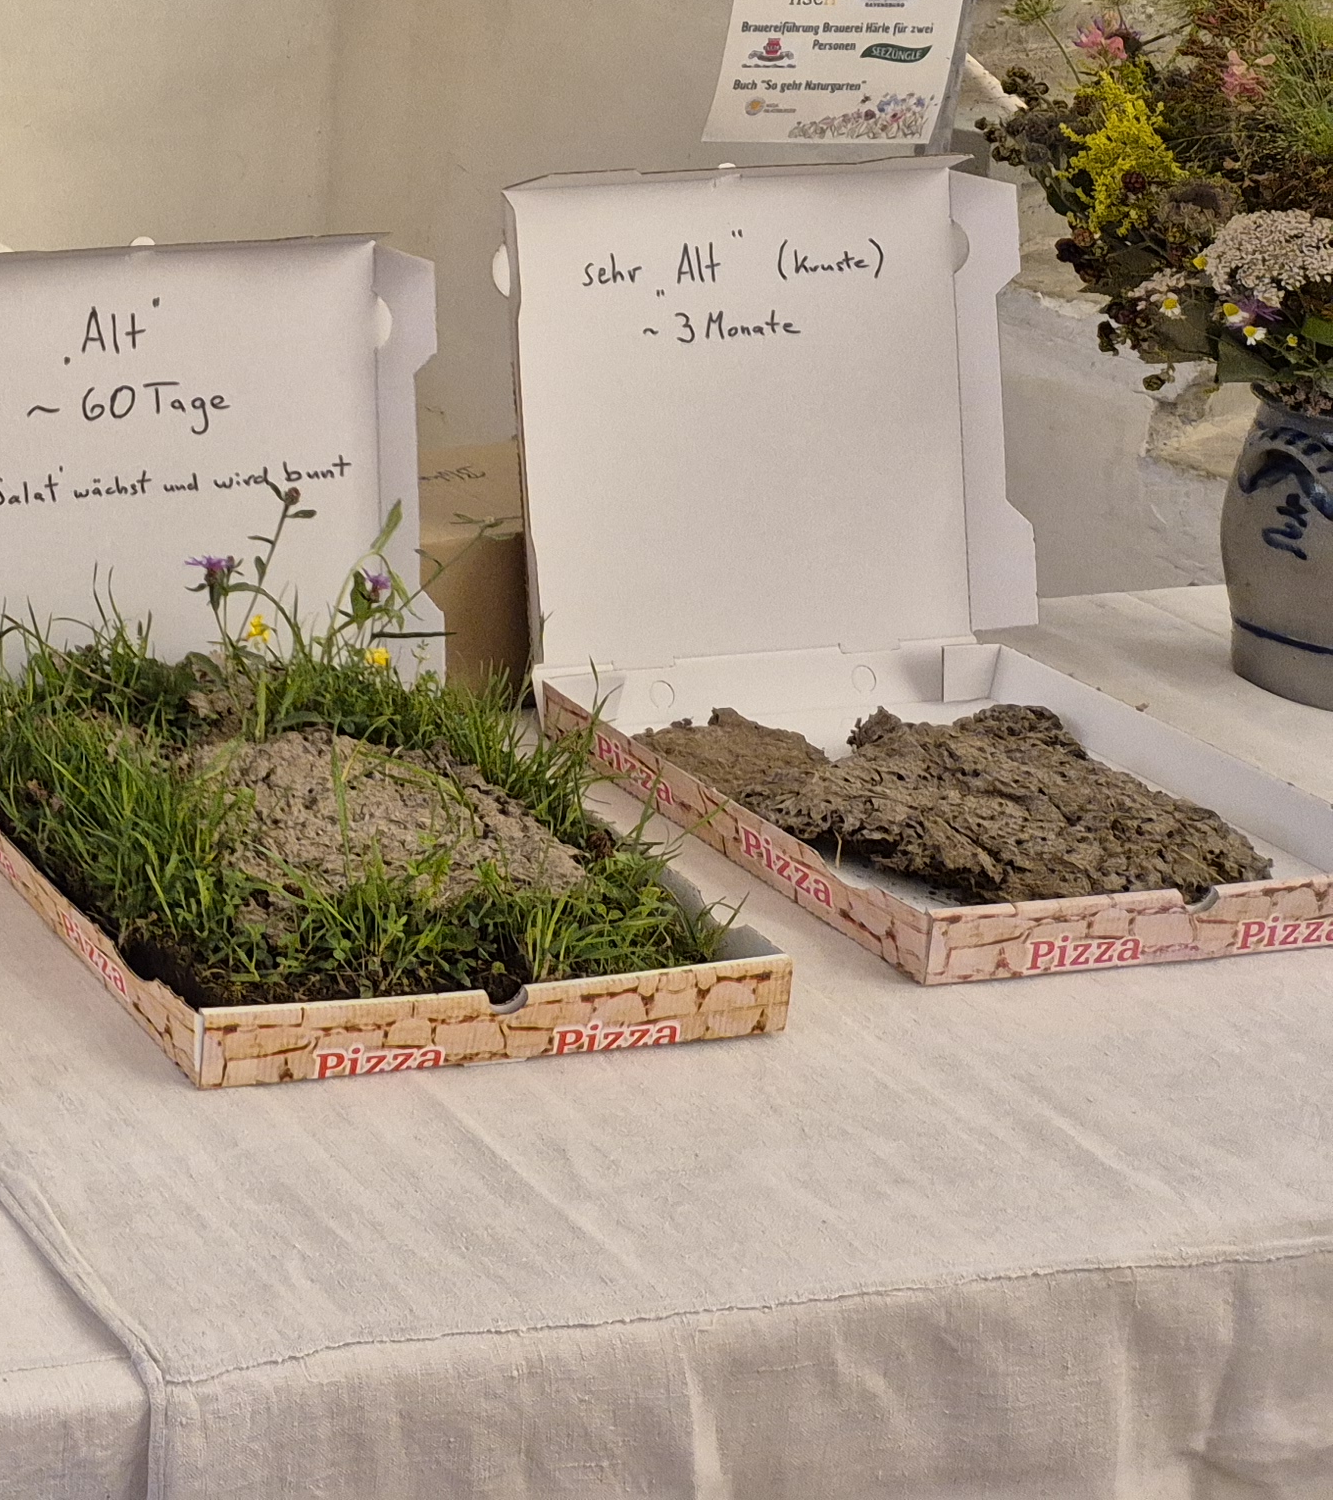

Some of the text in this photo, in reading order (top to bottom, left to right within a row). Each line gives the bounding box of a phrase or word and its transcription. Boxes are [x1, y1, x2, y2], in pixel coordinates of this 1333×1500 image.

[581, 252, 644, 287] sehr
[674, 308, 802, 344] 3 Monate
[81, 380, 232, 435] 60 Tage
[73, 469, 152, 499] wächst
[162, 472, 200, 493] und
[213, 465, 273, 490] wird
[282, 453, 353, 484] bunt
[595, 733, 834, 909] Pizza Pizza
[59, 908, 129, 998] Pizza
[1026, 934, 1143, 972] Pizza
[316, 1023, 680, 1079] Pizza Pizza
